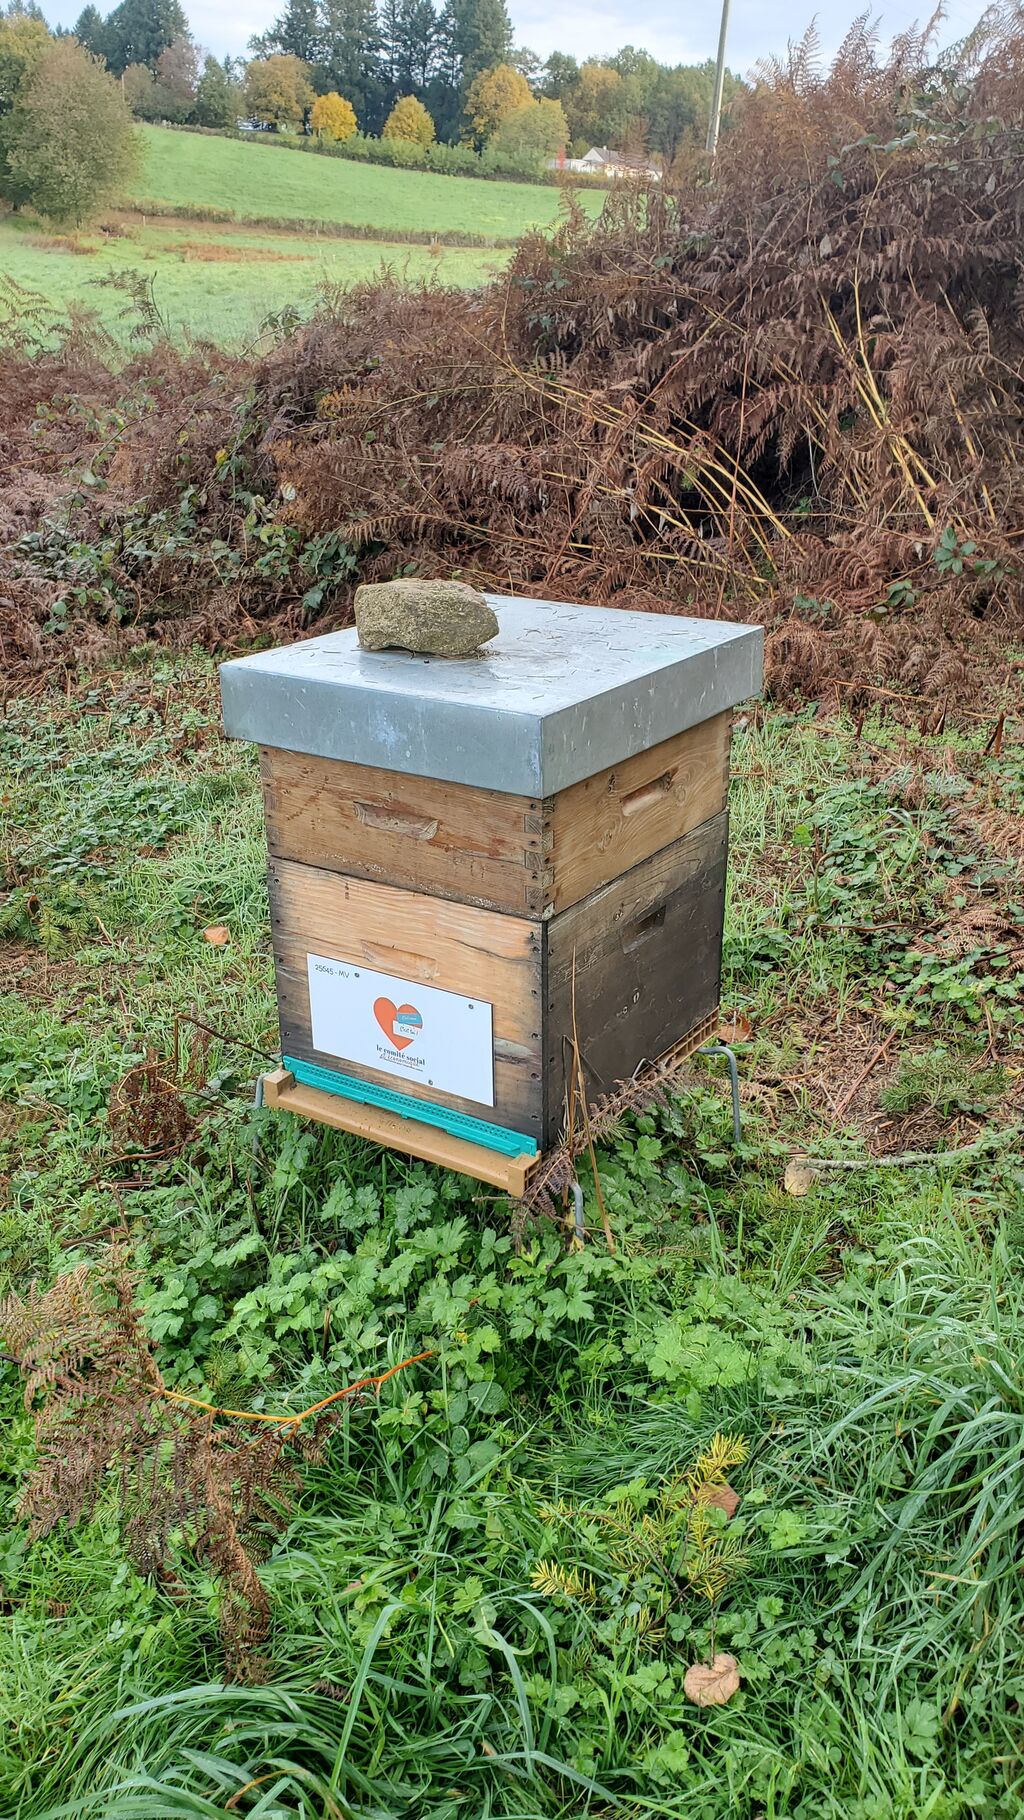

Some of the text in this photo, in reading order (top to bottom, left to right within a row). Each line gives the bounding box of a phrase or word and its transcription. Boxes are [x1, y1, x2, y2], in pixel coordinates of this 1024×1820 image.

[338, 969, 350, 979] MV
[376, 1044, 383, 1052] le
[383, 1048, 406, 1060] comité
[406, 1055, 426, 1066] social
